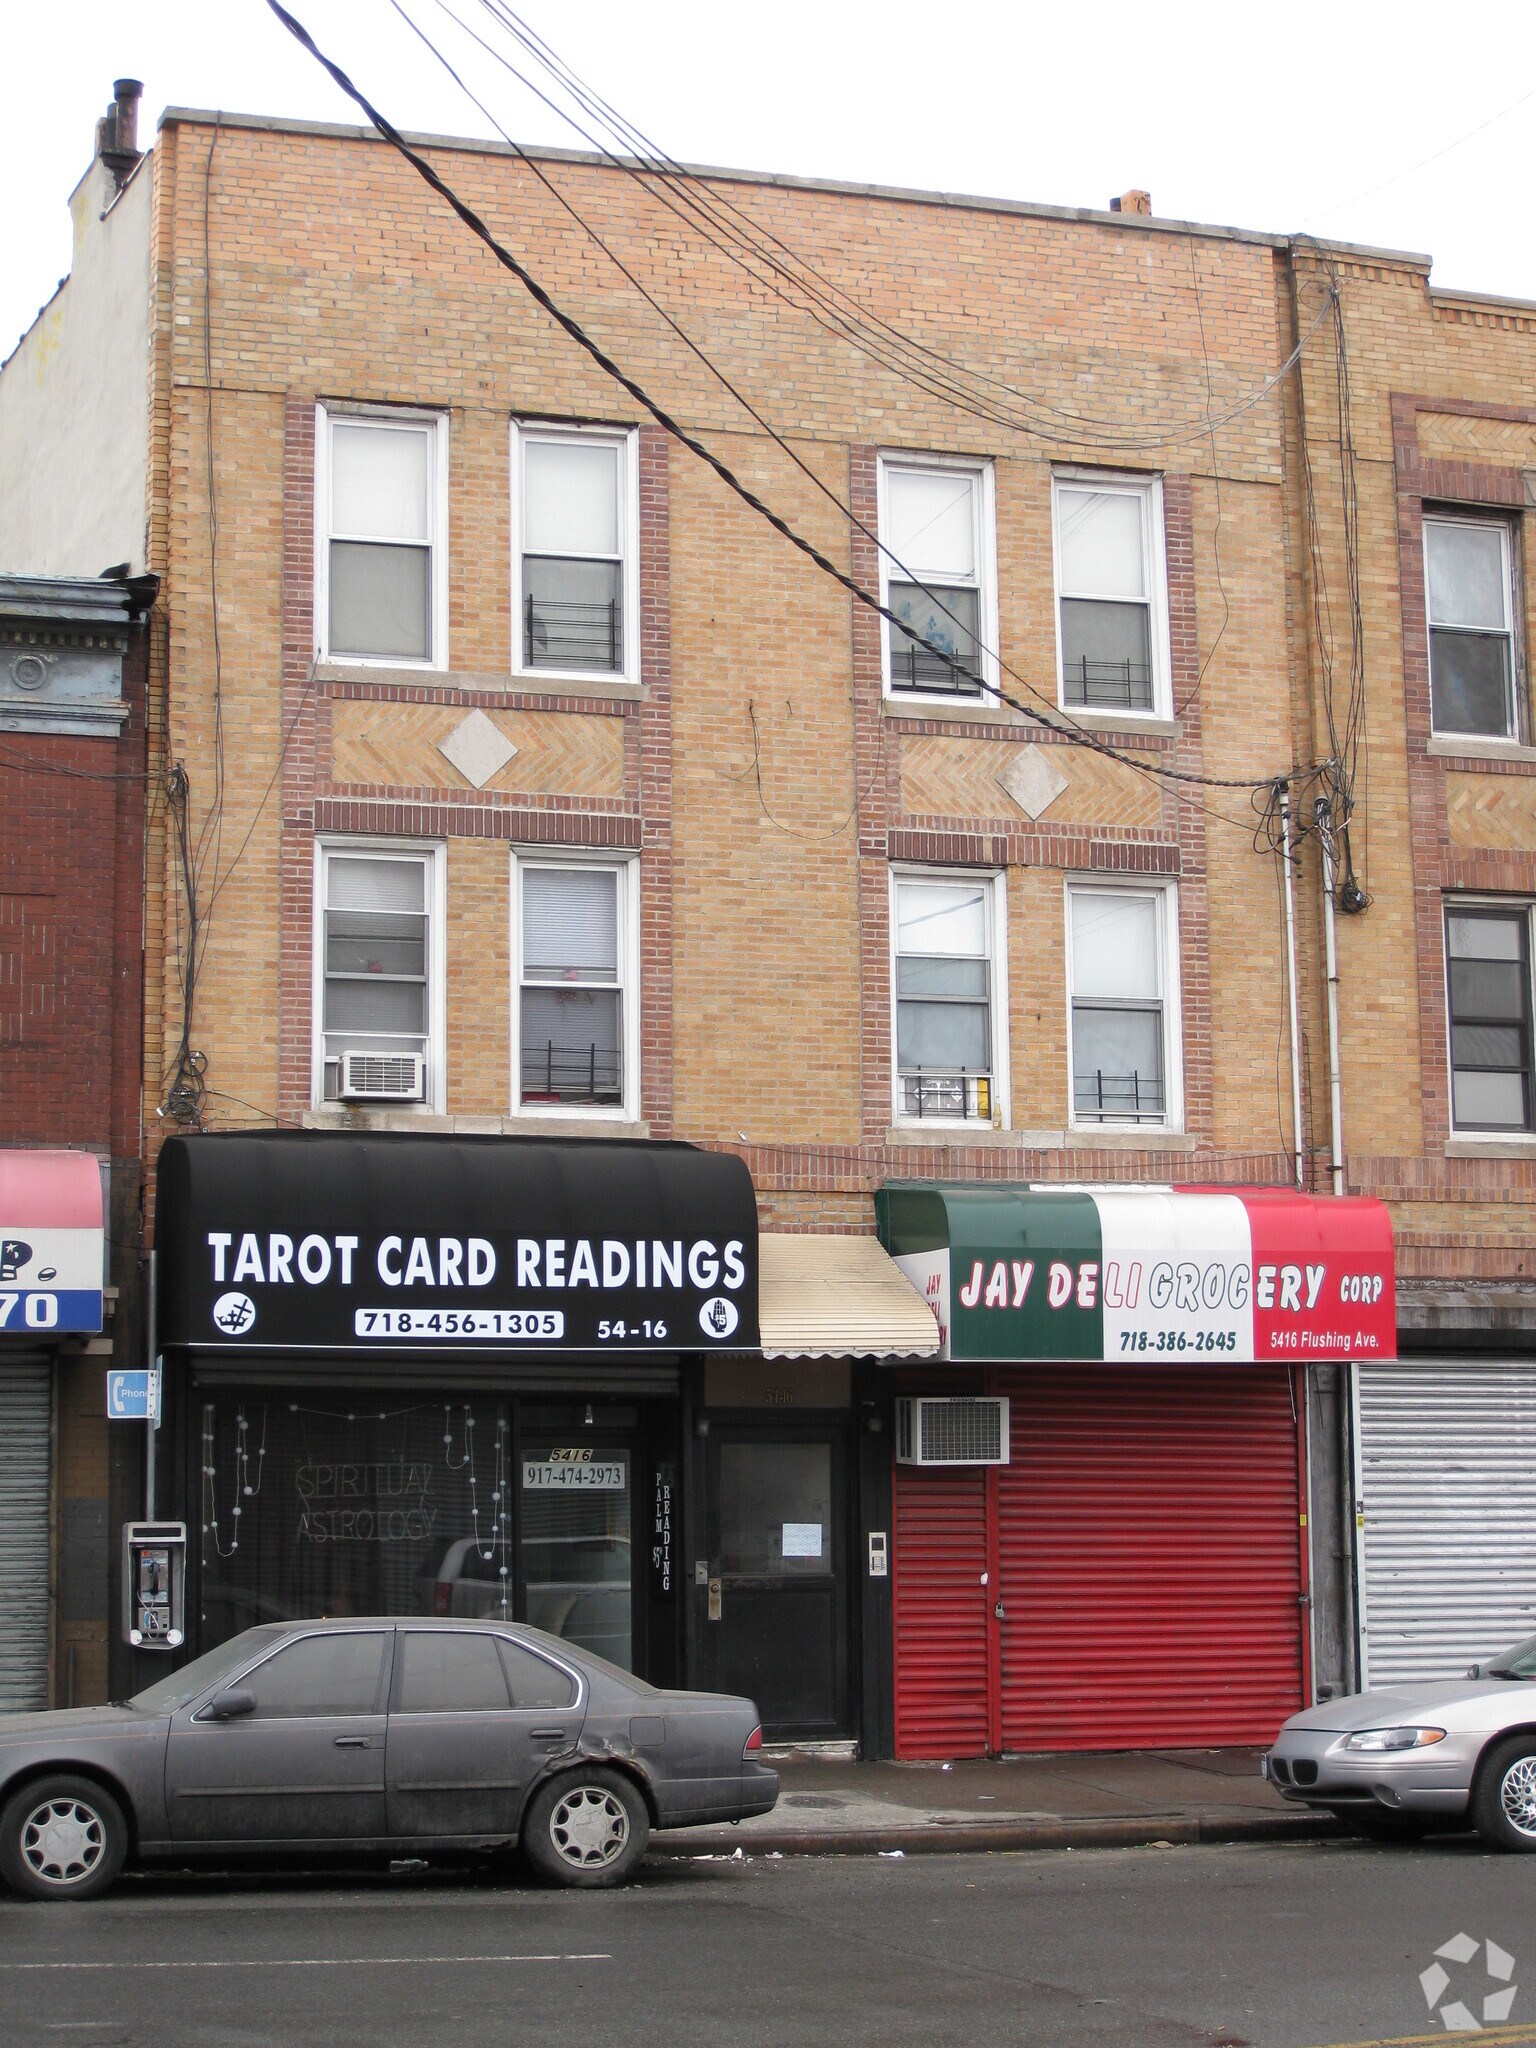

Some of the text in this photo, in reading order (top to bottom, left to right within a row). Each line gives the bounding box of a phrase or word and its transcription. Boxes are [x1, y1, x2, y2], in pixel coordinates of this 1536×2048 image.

[208, 1232, 745, 1289] TAROT CARD READINGS
[926, 1274, 941, 1295] JAY
[960, 1260, 1383, 1312] JAY DELI GROCERY CORP
[364, 1313, 556, 1334] 718-456-1305
[597, 1320, 667, 1338] 54-16
[1120, 1331, 1237, 1351] 718-386-2645
[1270, 1331, 1379, 1351] 5416 Flushing Ave.
[551, 1449, 592, 1462] 5416
[527, 1466, 622, 1485] 917-474-2973
[297, 1508, 437, 1544] ASTROLOGY
[663, 1485, 671, 1591] READING
